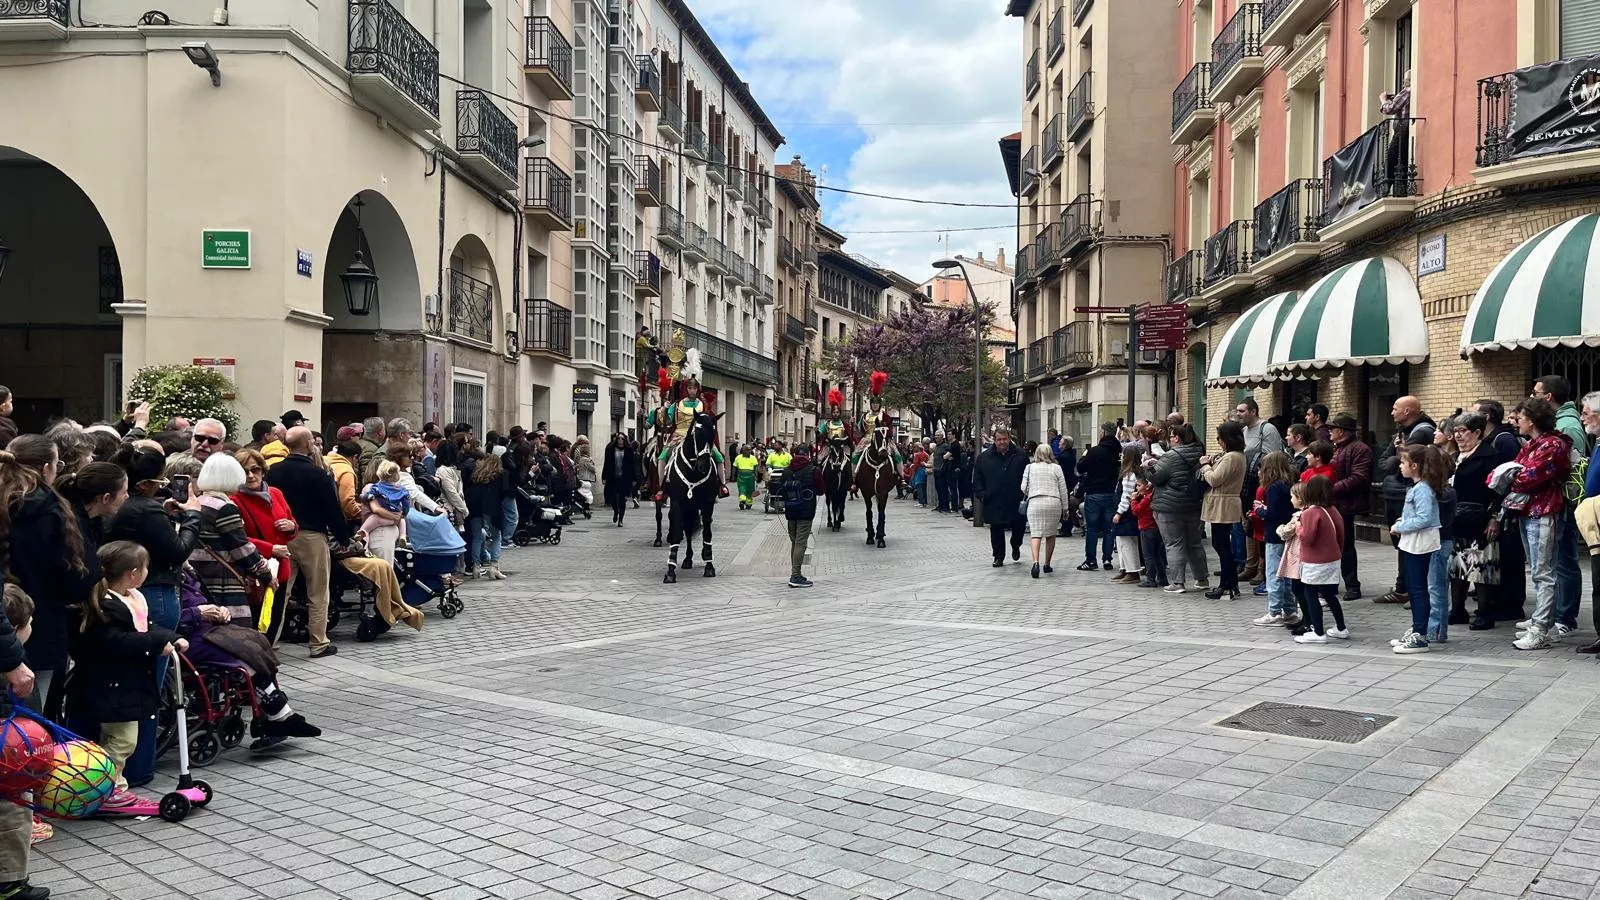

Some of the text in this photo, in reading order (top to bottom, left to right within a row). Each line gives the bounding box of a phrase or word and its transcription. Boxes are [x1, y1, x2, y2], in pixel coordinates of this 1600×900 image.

[1526, 125, 1596, 142] SEMANA
[1427, 243, 1440, 253] COSO
[299, 252, 312, 263] COSO
[299, 263, 312, 274] ALTO
[1422, 258, 1440, 269] ALTO
